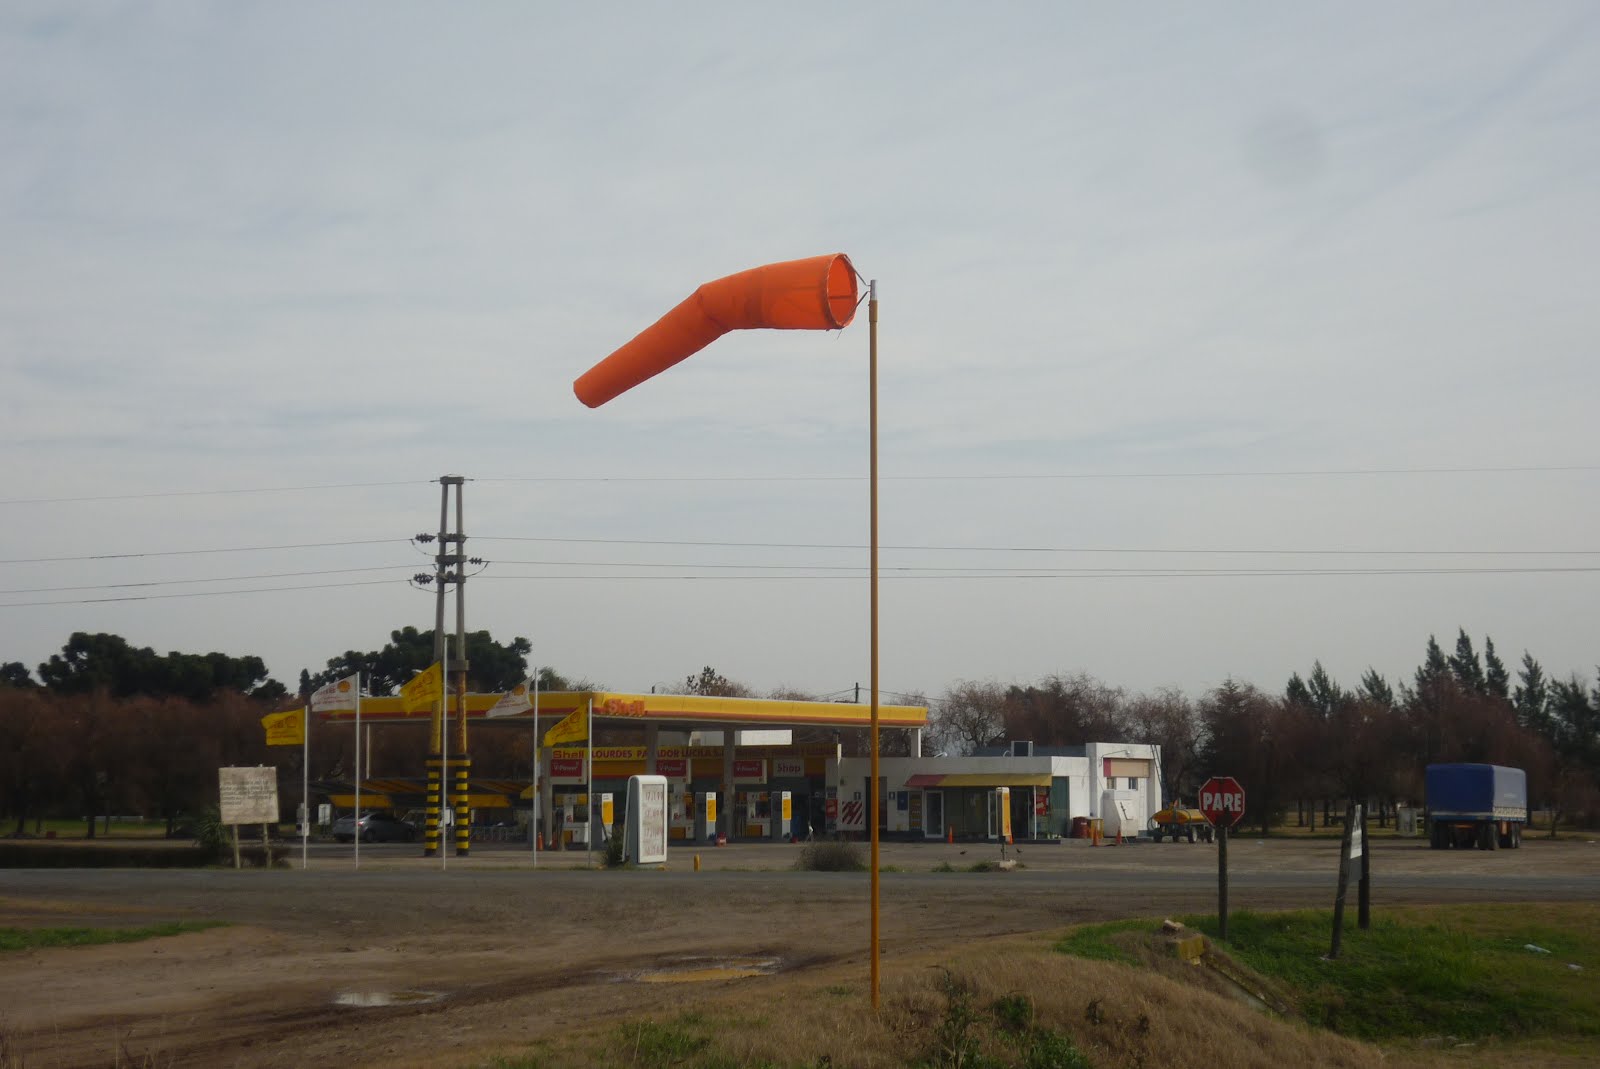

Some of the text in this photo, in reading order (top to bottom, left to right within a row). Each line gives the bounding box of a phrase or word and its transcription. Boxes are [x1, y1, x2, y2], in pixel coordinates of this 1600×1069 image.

[608, 699, 645, 715] Shell
[552, 750, 584, 759] Shell
[591, 750, 632, 758] LOURDES
[777, 763, 801, 774] Shop
[1203, 792, 1241, 811] PARE
